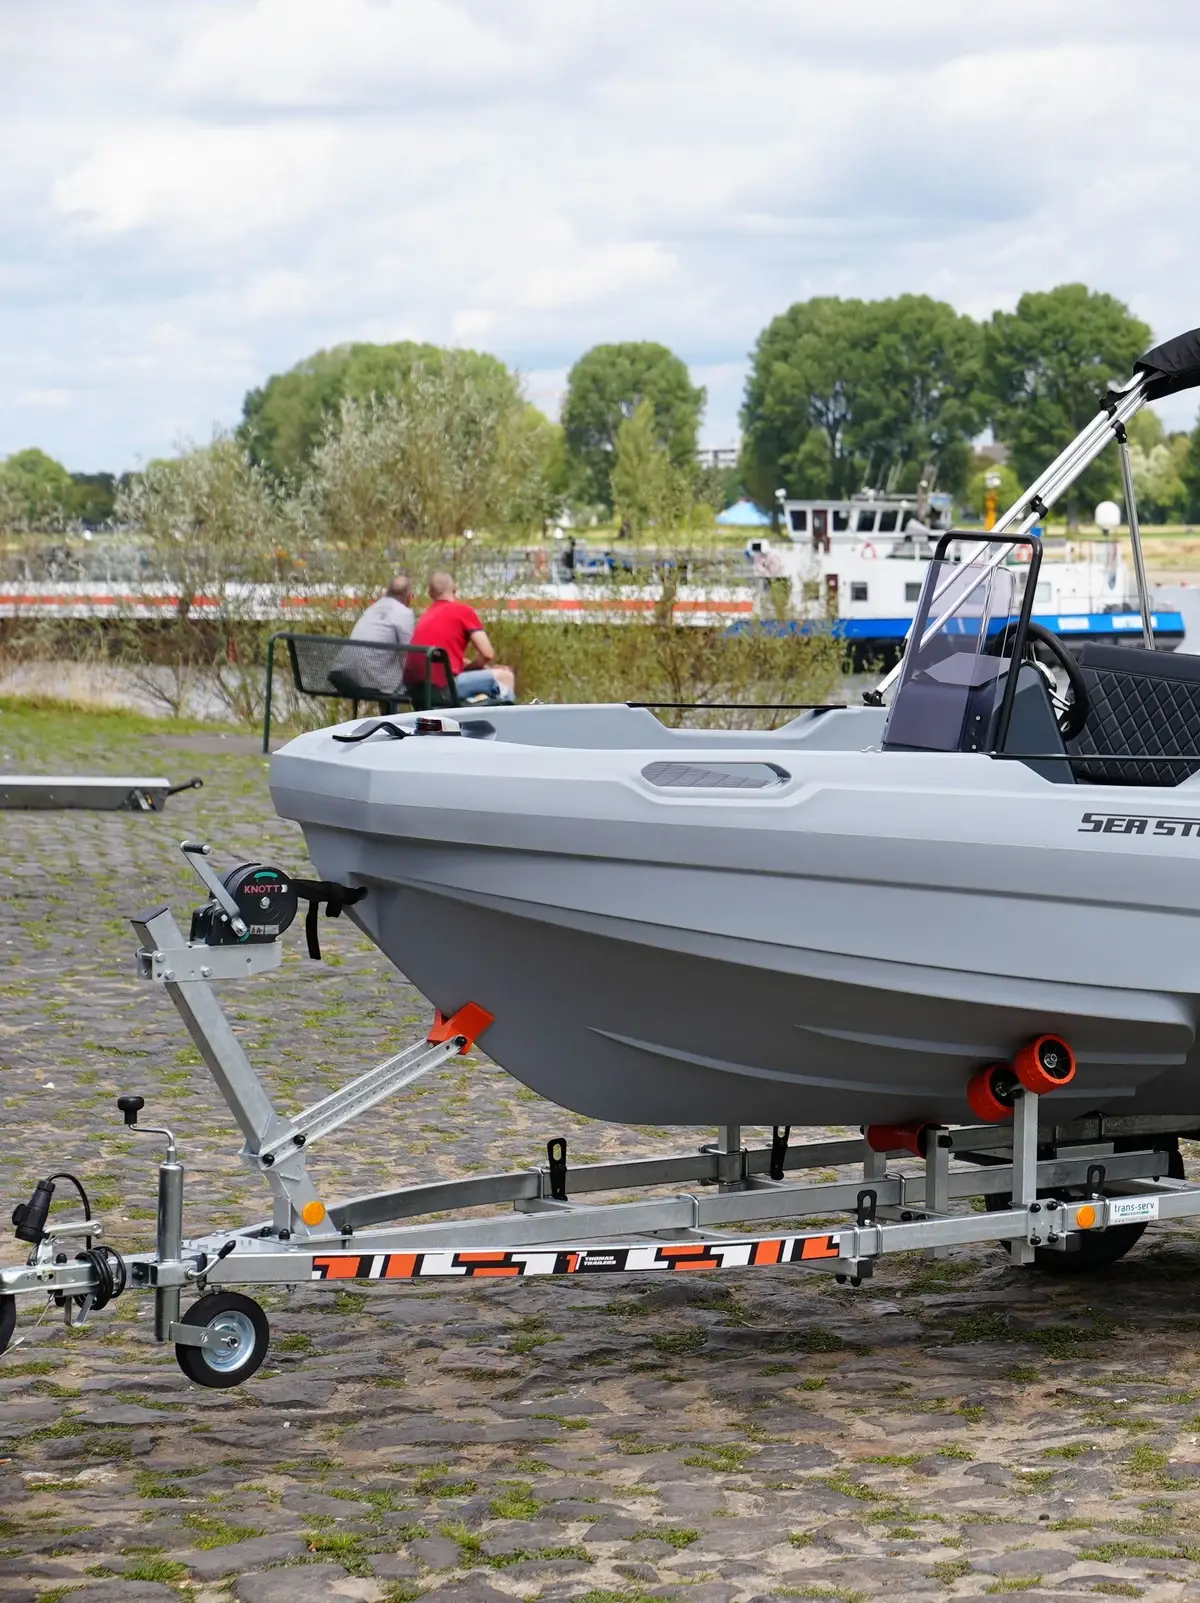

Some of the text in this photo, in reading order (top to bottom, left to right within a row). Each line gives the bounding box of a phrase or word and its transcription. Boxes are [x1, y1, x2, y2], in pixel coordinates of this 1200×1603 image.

[1077, 812, 1148, 835] SEA
[244, 884, 280, 894] KNOTT
[1114, 1202, 1155, 1213] trans-serv
